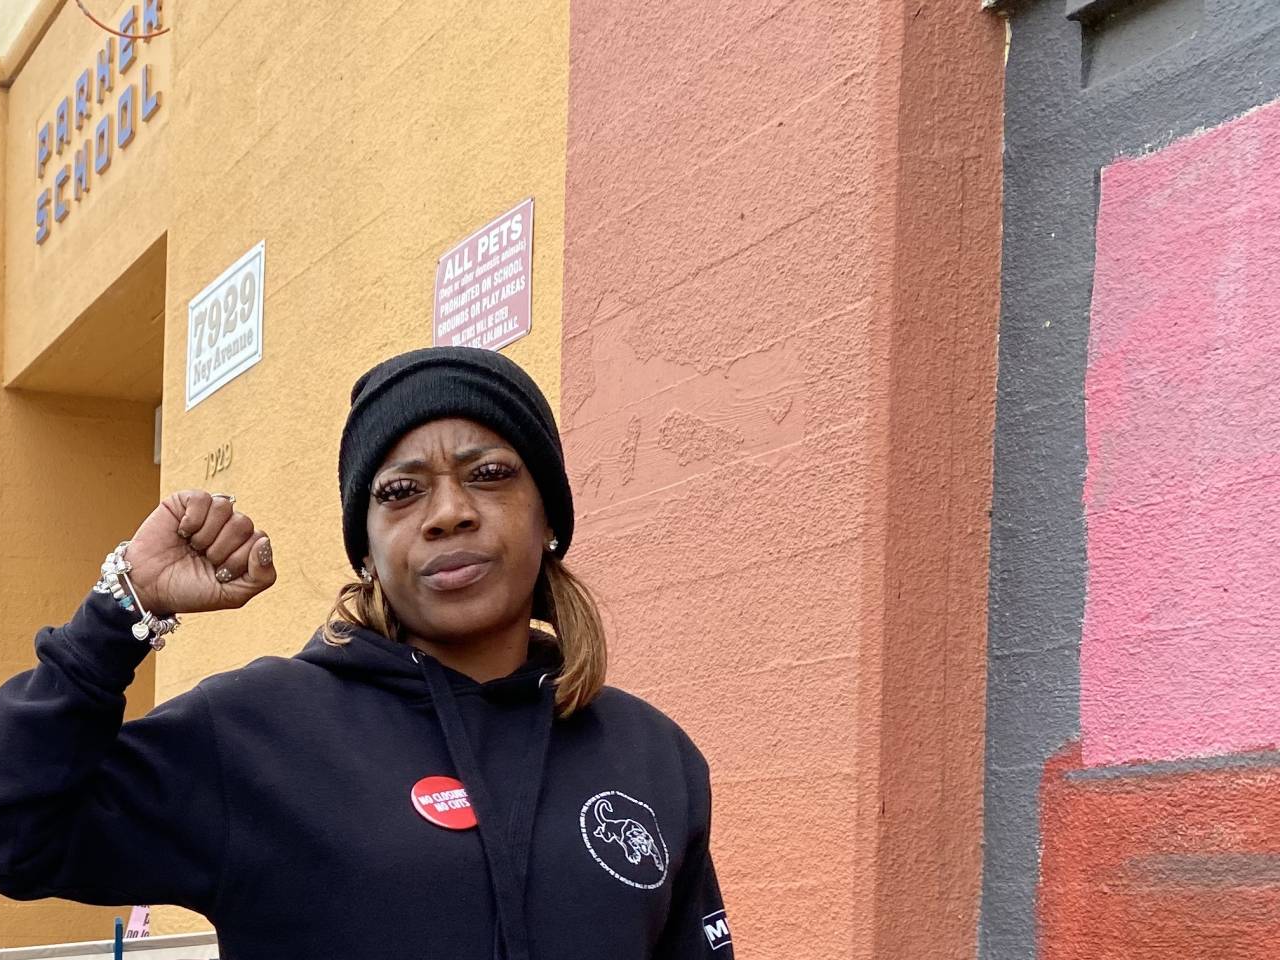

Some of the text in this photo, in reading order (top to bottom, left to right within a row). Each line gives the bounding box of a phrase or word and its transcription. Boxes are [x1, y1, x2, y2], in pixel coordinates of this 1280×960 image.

[38, 0, 162, 179] PARKER
[36, 64, 161, 245] SCHOOL
[443, 213, 523, 285] ALL PETS
[194, 271, 256, 359] 7929
[437, 308, 469, 337] GROUNDS
[470, 299, 480, 319] OR
[481, 290, 500, 313] PLAY
[501, 275, 526, 302] AREAS
[440, 258, 523, 319] PROHIBITED ON SCHOOL
[193, 327, 254, 386] Ney Avenue
[204, 440, 233, 480] 7929
[417, 794, 434, 806] NO
[434, 801, 449, 812] NO
